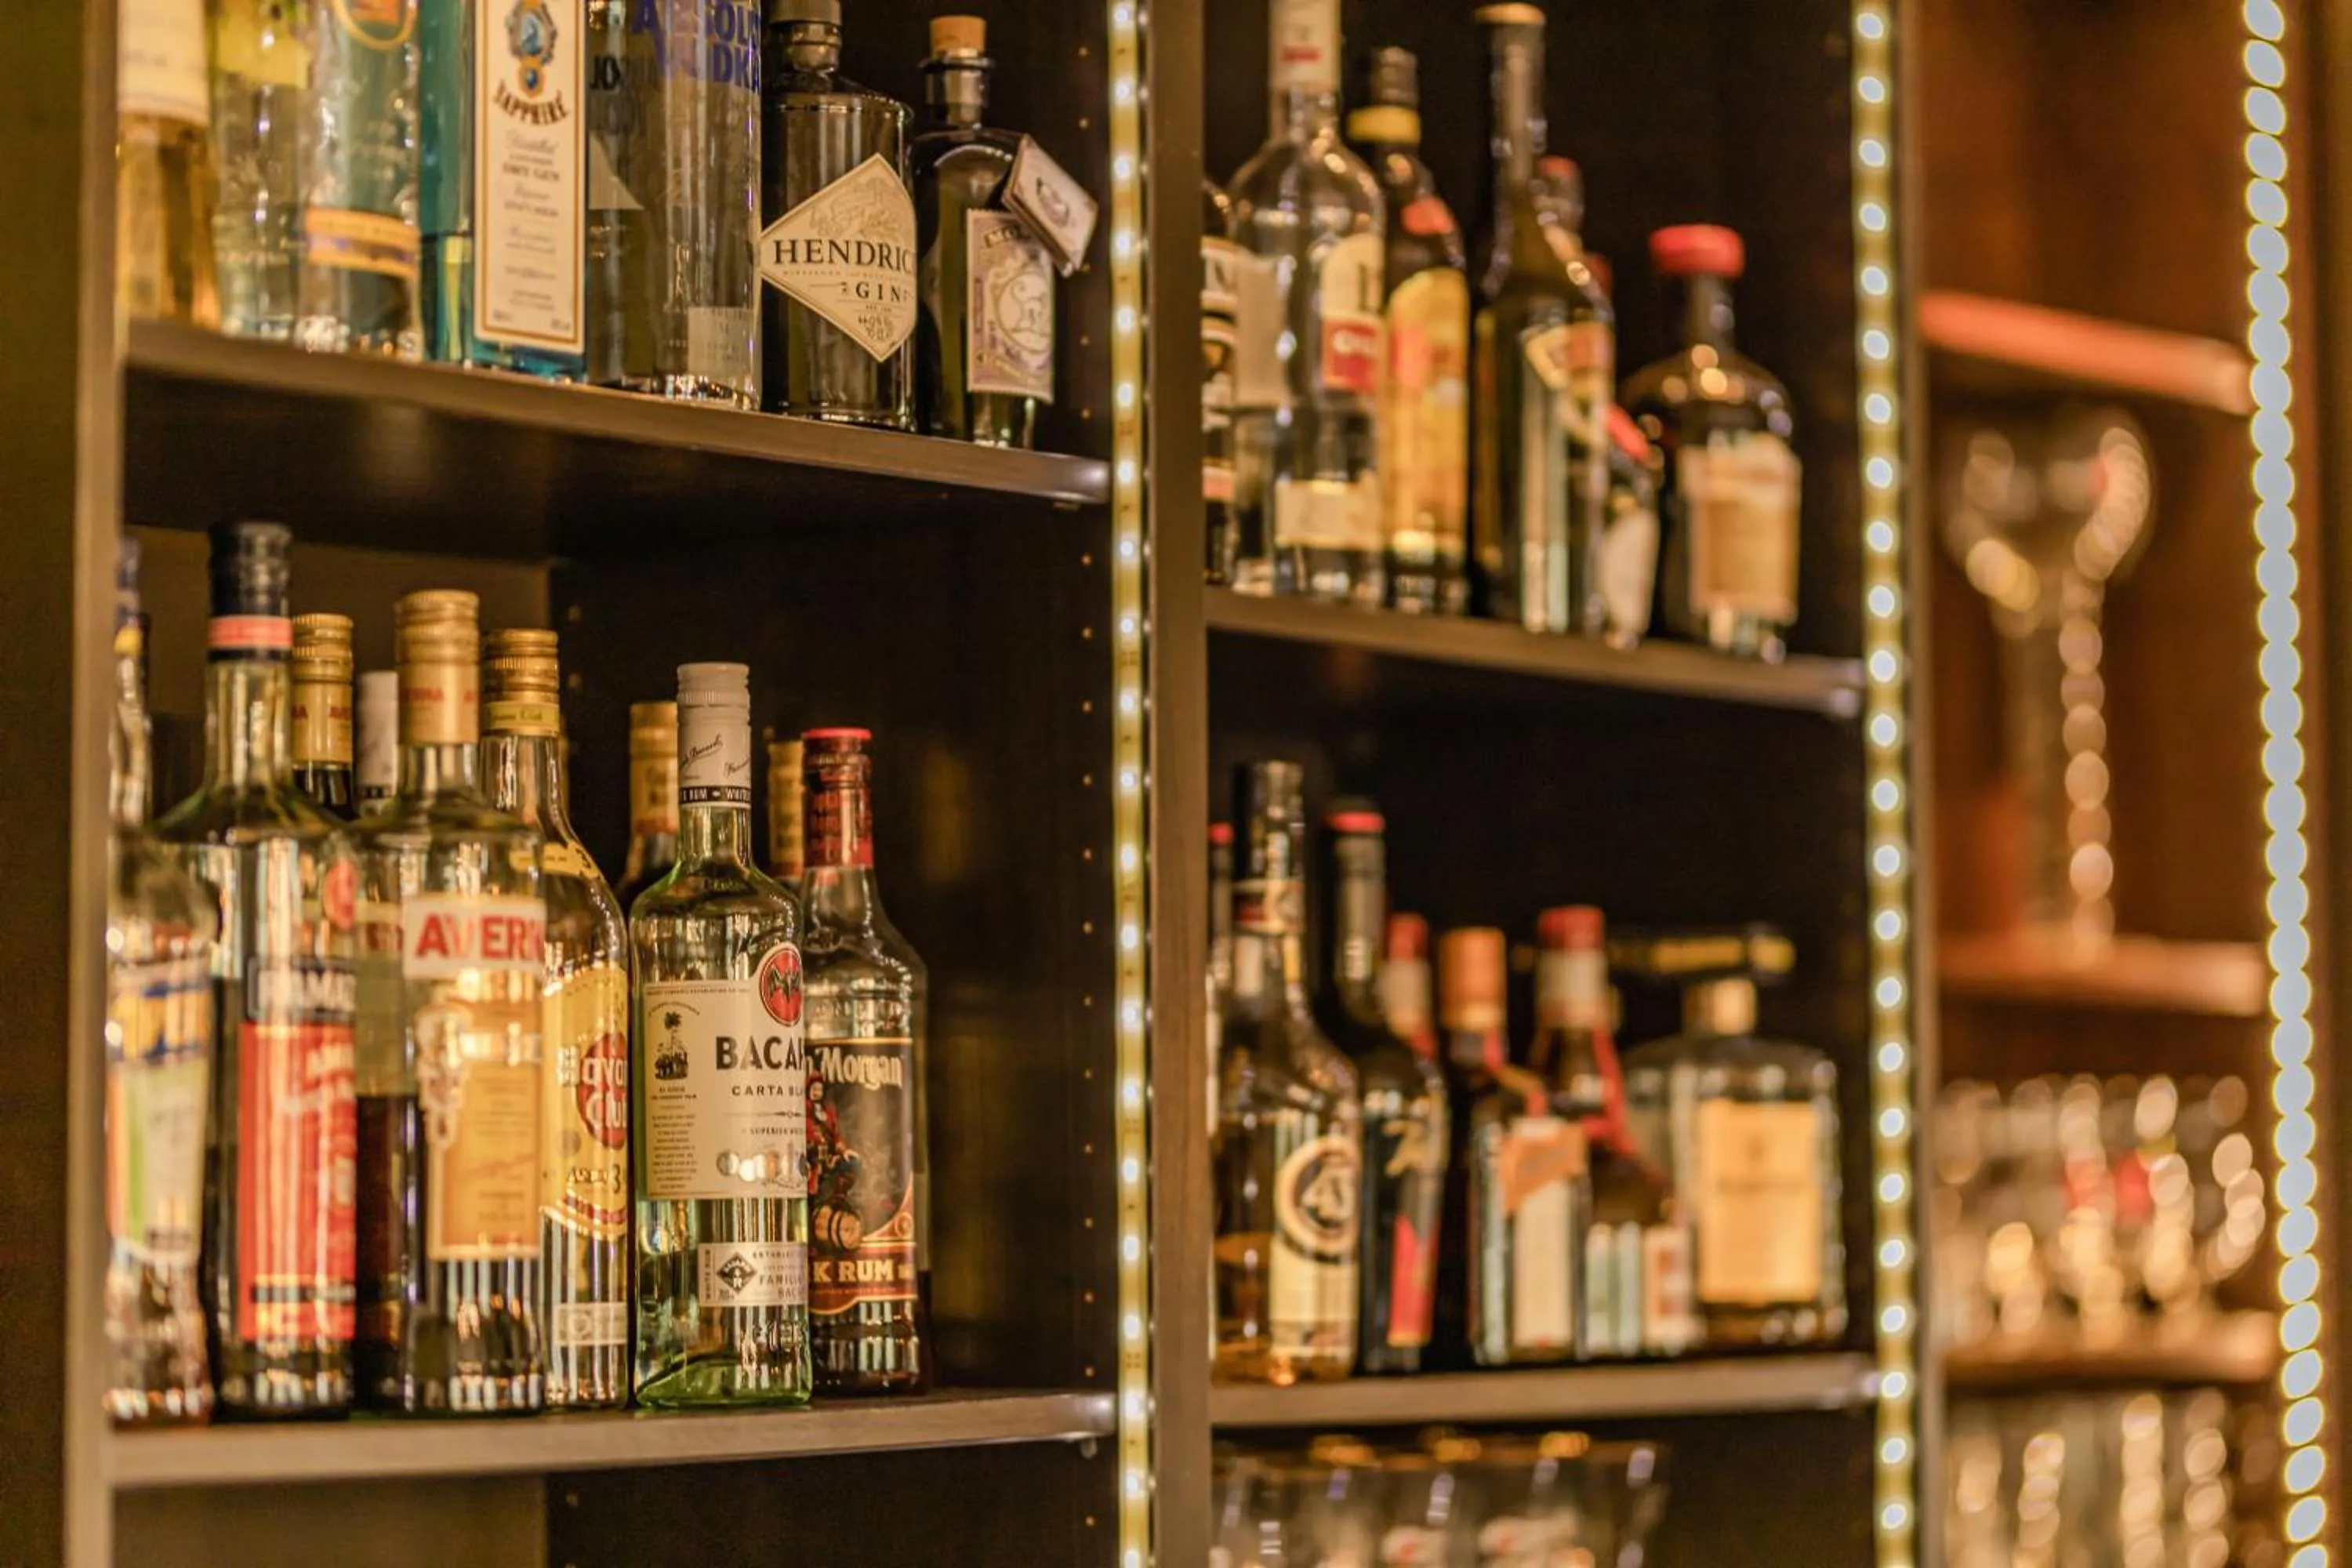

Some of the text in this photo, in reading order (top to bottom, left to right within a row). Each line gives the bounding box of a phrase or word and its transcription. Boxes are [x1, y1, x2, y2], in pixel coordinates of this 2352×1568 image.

[494, 79, 572, 125] SAPPHIRE
[855, 281, 901, 302] GIN
[815, 1046, 903, 1091] Morgan
[731, 1086, 783, 1096] CARTA
[838, 1258, 894, 1283] RUM
